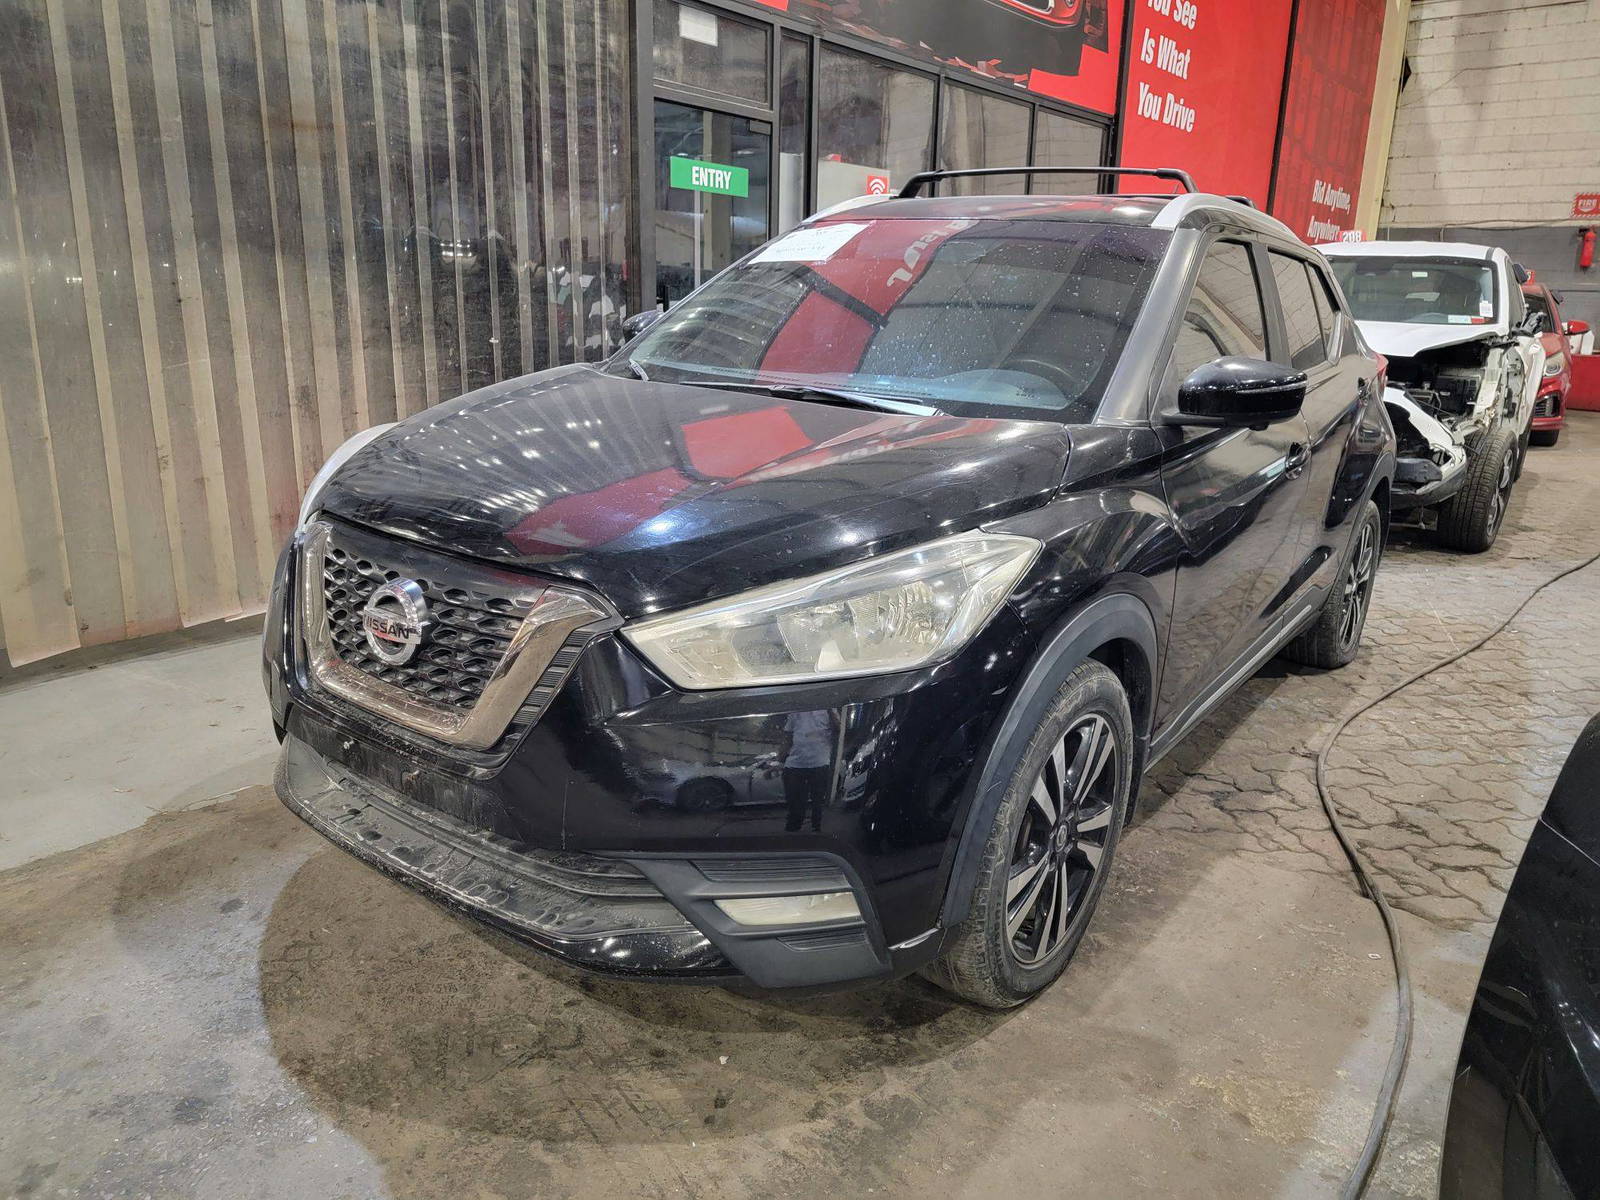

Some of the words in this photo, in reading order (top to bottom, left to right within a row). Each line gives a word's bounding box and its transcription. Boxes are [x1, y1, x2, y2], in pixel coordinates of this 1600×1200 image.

[1147, 0, 1172, 16] ou
[1173, 0, 1197, 30] See
[1140, 27, 1155, 65] Is
[1157, 34, 1191, 80] What
[1137, 81, 1162, 121] You
[1162, 92, 1196, 133] Drive
[692, 165, 732, 190] ENTRY
[1312, 179, 1326, 204] Bid
[1323, 183, 1351, 215] Anytime,
[1578, 199, 1597, 209] FIRE
[366, 616, 410, 640] NISSAN
